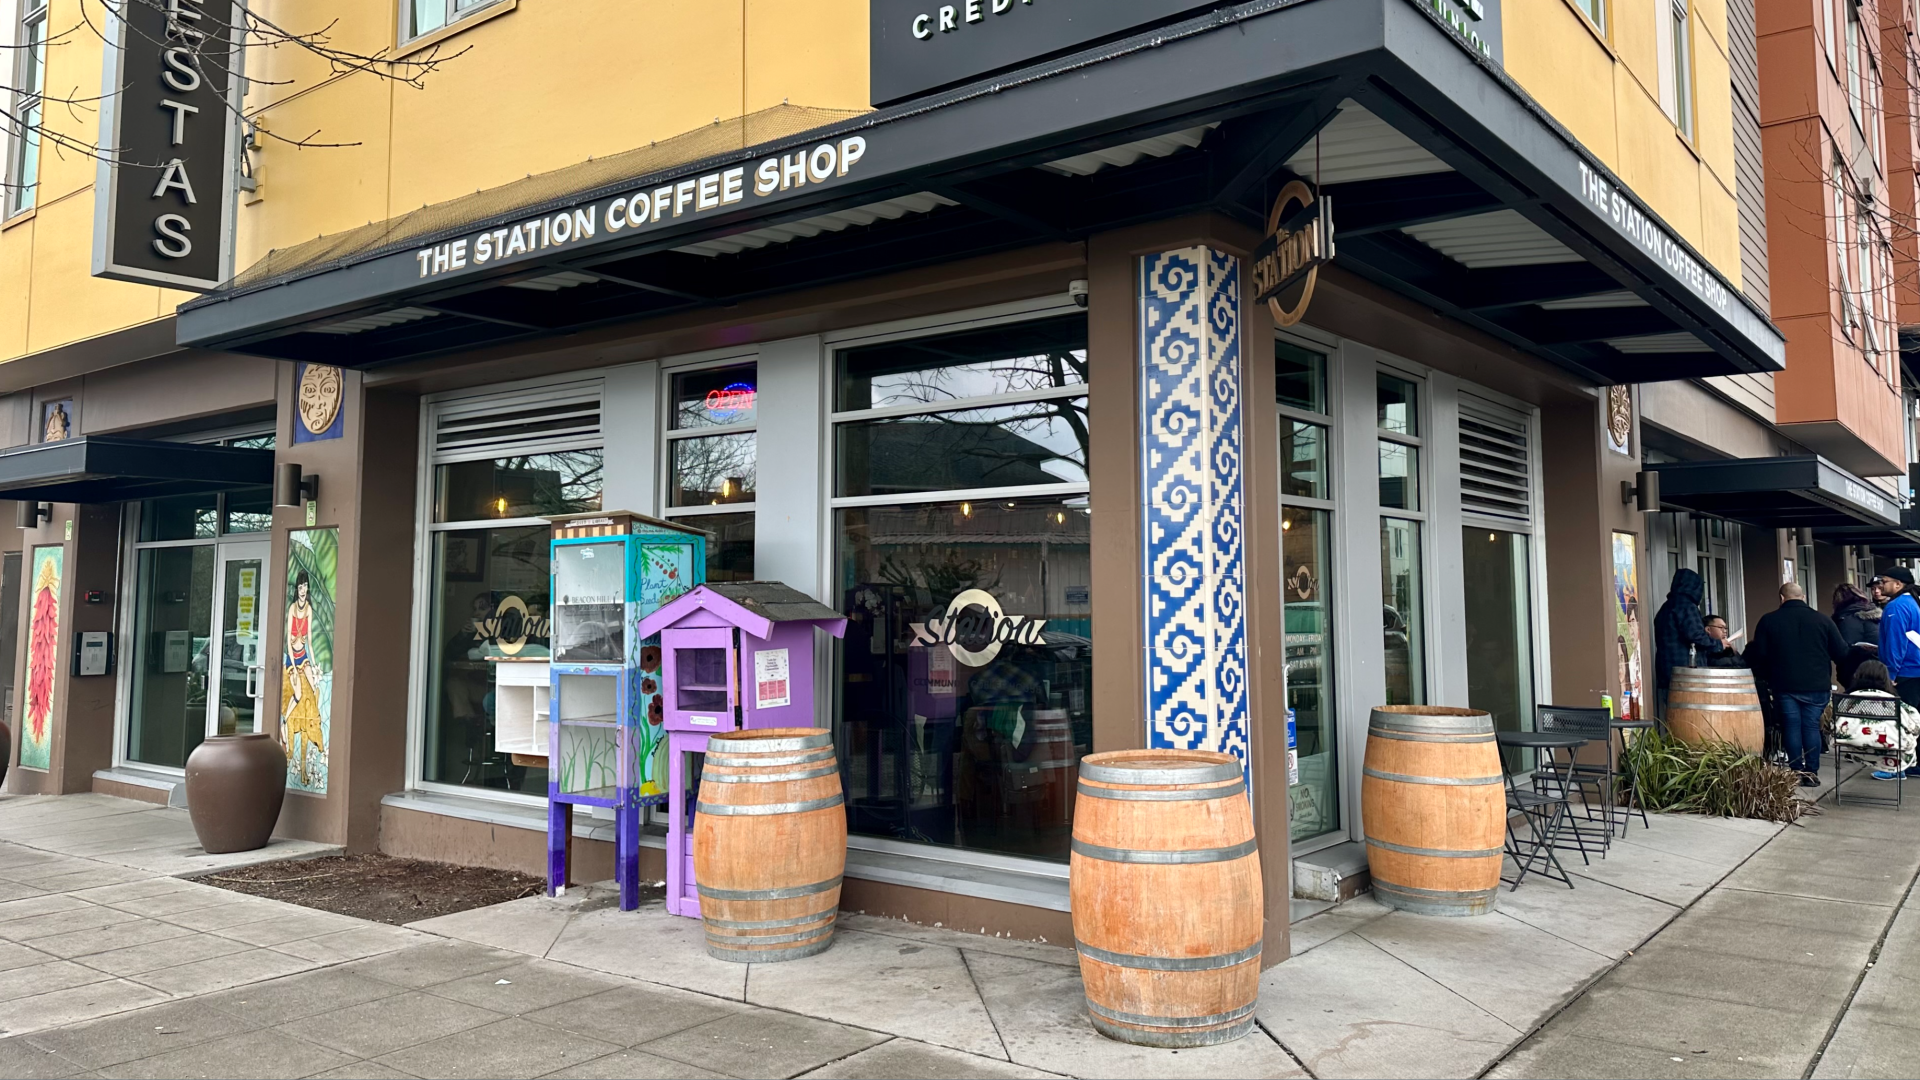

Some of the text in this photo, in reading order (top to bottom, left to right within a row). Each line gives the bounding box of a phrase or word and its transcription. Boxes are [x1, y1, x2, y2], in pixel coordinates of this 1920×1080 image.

[912, 0, 1033, 39] CRED
[417, 136, 867, 278] THE STATION COFFEE SHOP
[1579, 161, 1728, 310] THE STATION COFFEE SHOP
[1252, 217, 1320, 299] STATION
[705, 389, 755, 410] OPEN
[641, 577, 669, 591] Plant
[571, 595, 611, 604] BEACON HILL
[917, 604, 1040, 647] Station
[1285, 633, 1325, 643] MONDAY FRIDAY
[1300, 787, 1309, 799] NO
